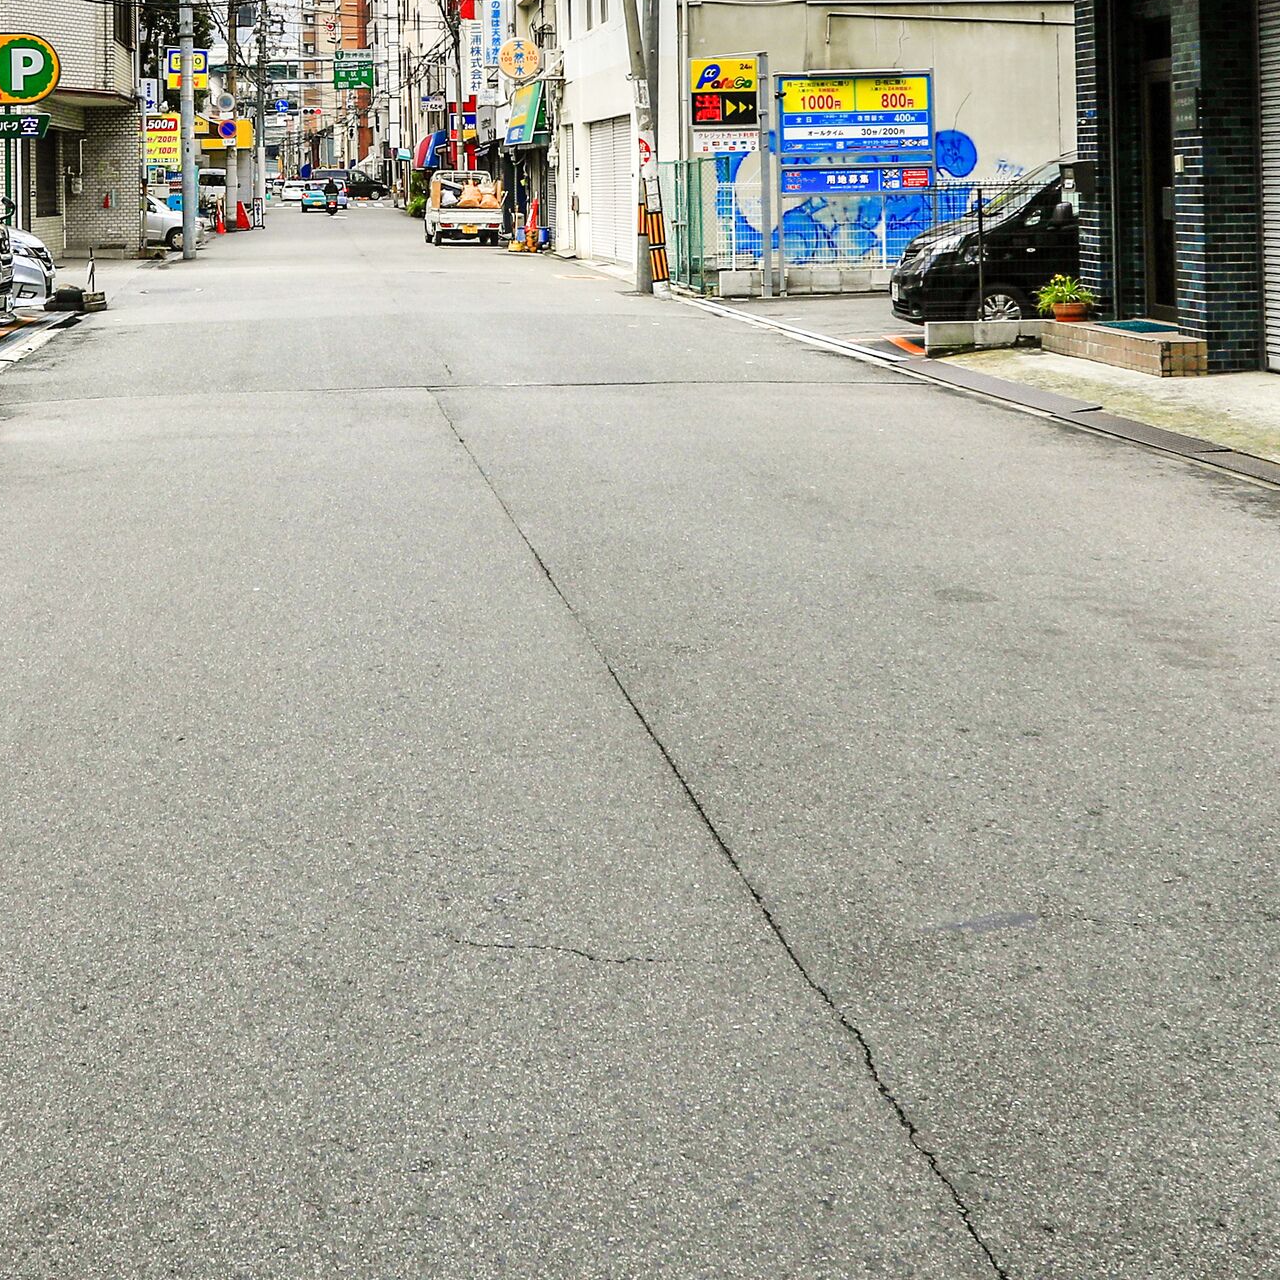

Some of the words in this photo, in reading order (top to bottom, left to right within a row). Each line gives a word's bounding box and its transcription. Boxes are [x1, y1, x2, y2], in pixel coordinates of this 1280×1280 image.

[513, 40, 525, 76] 天然水
[10, 48, 45, 91] P
[800, 94, 841, 110] 1000円
[881, 93, 914, 108] 800円
[20, 116, 39, 135] 空
